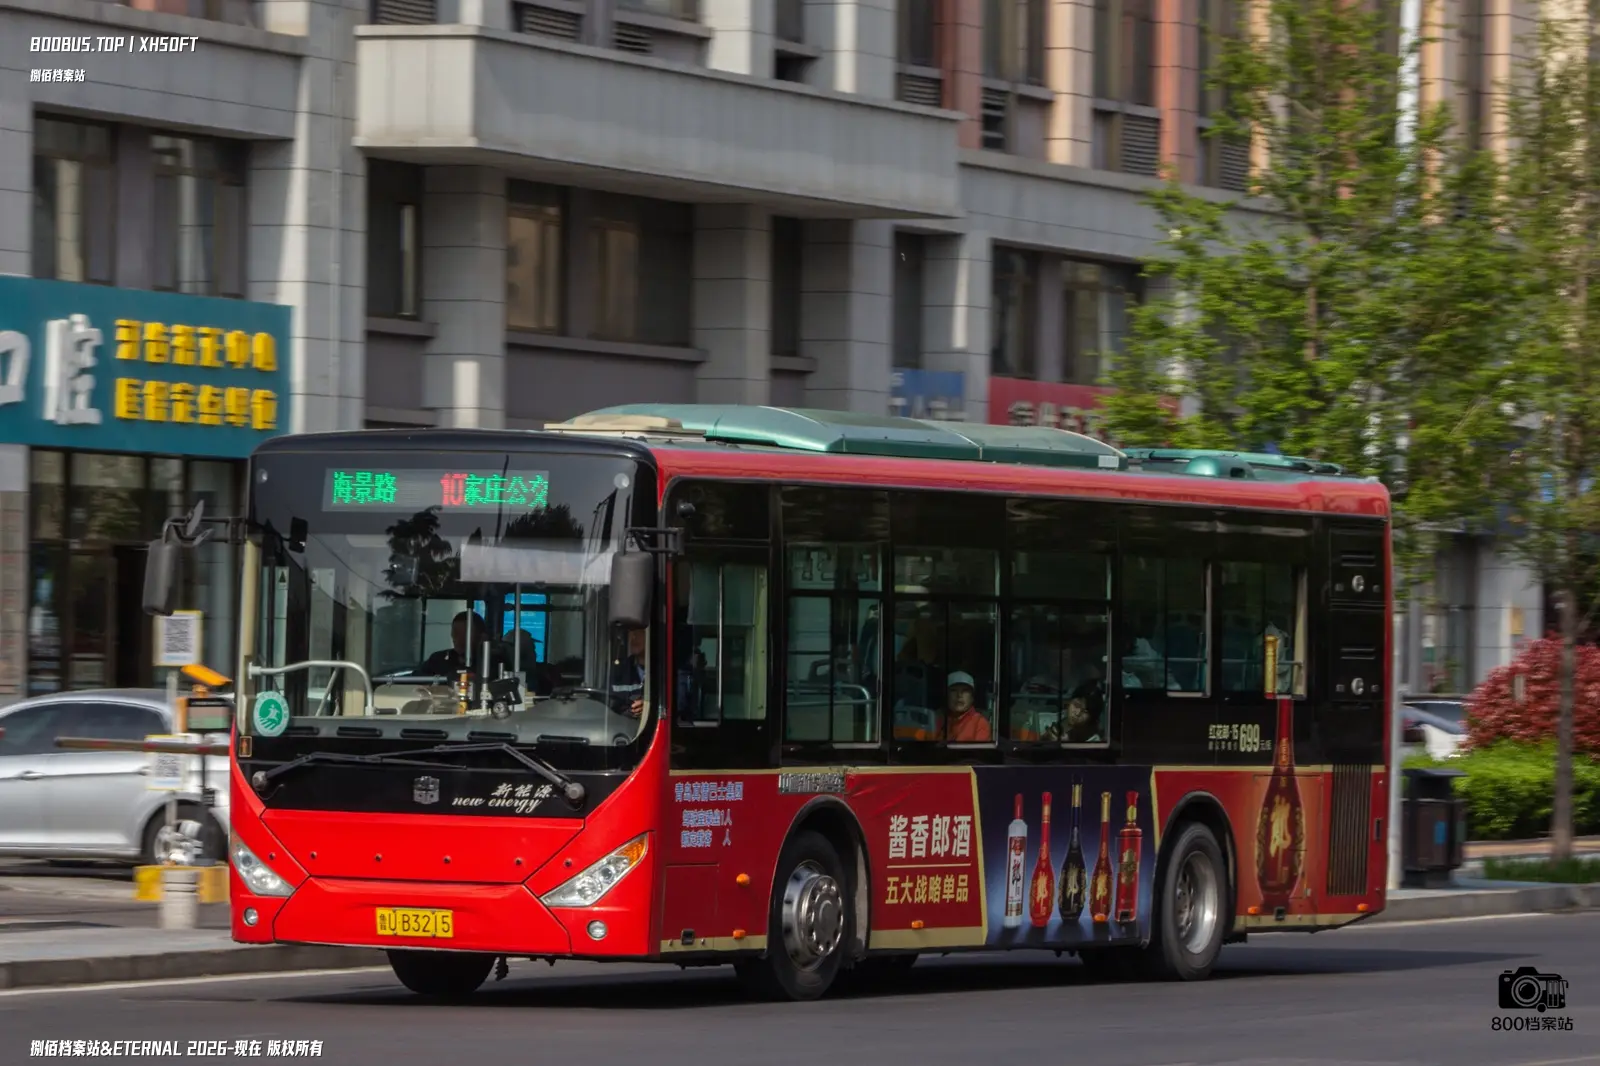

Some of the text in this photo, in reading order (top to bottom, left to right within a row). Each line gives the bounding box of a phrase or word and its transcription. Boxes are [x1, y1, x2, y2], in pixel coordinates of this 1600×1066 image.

[332, 471, 397, 504] 海景路
[1239, 723, 1260, 752] 699
[451, 796, 542, 814] new energy
[491, 783, 553, 798] 新能源
[888, 814, 971, 859] 酱香郎酒
[885, 874, 969, 905] 五大战略单品
